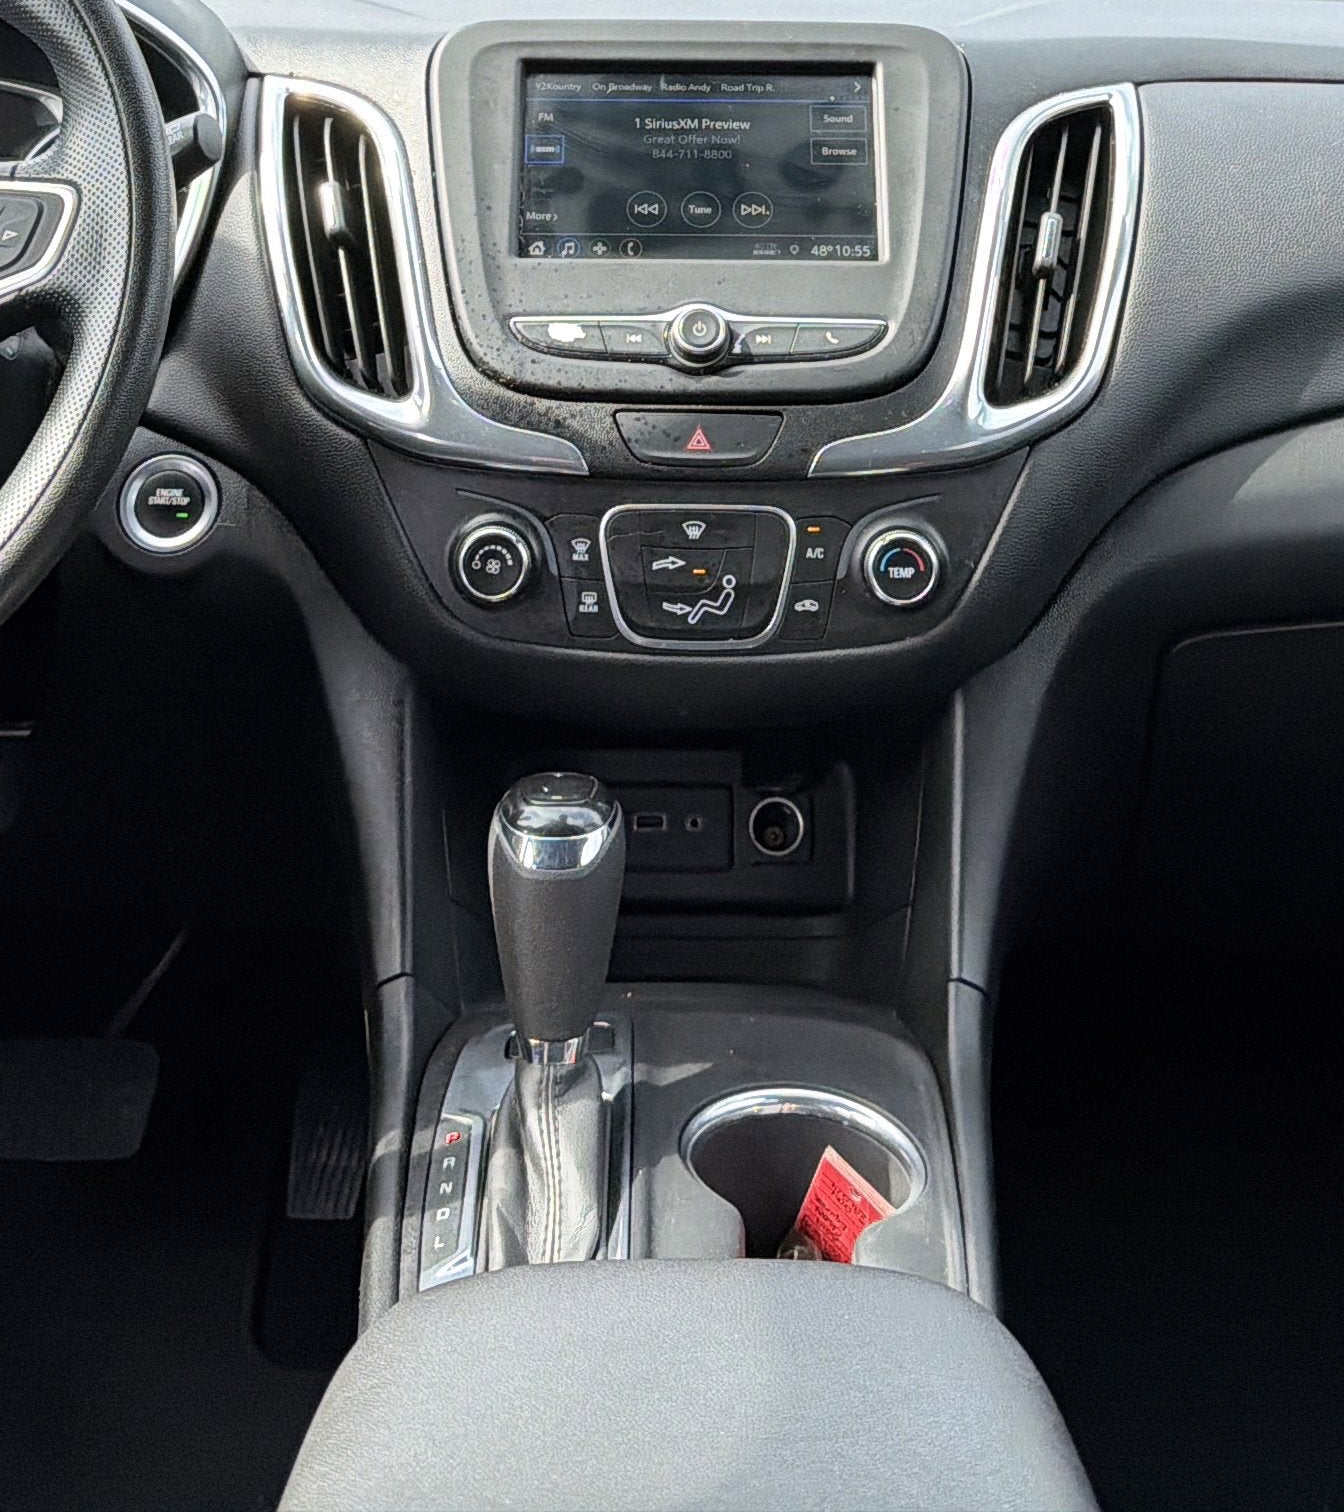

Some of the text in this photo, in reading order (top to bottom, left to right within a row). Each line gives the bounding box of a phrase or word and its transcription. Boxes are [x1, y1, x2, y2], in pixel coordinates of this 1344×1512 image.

[536, 82, 775, 94] Y2Kountry On Broadway Radio Andy Road Trip R.
[538, 113, 554, 122] FM
[823, 114, 853, 123] Sound
[634, 117, 751, 130] 1 SiriusXM Preview
[643, 134, 741, 145] Great Offer Now!
[652, 149, 732, 159] 844-711-8800
[821, 146, 857, 156] Browse
[688, 205, 712, 215] Tune
[526, 211, 552, 221] More
[835, 245, 871, 257] 10:55
[156, 488, 184, 497] ENGINE
[147, 496, 190, 506] START/STOP
[572, 553, 590, 562] MAX
[806, 547, 825, 561] A/C
[888, 566, 915, 580] TEMP
[579, 604, 599, 613] REAR
[445, 1131, 461, 1145] P
[443, 1156, 456, 1170] R
[439, 1181, 453, 1195] N
[436, 1207, 451, 1222] D
[433, 1236, 445, 1251] L
